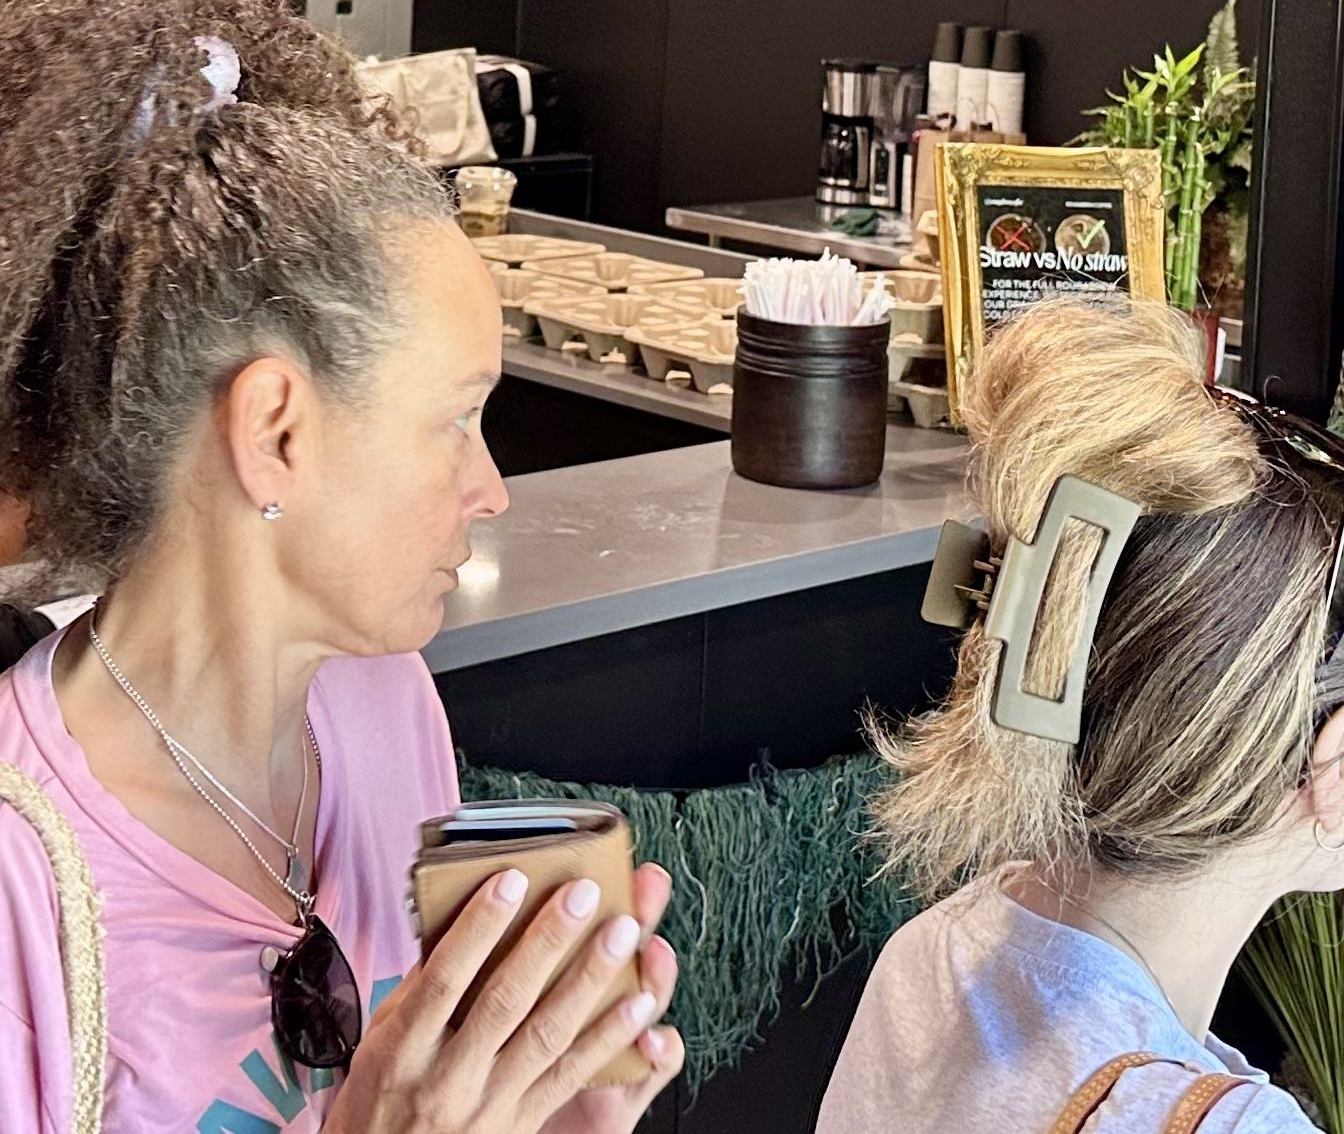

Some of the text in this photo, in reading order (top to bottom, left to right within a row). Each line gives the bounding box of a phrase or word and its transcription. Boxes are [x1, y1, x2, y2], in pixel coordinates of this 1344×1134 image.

[980, 246, 1128, 271] Straw vs No straw
[992, 279, 1012, 289] FOR
[1013, 280, 1031, 290] THE
